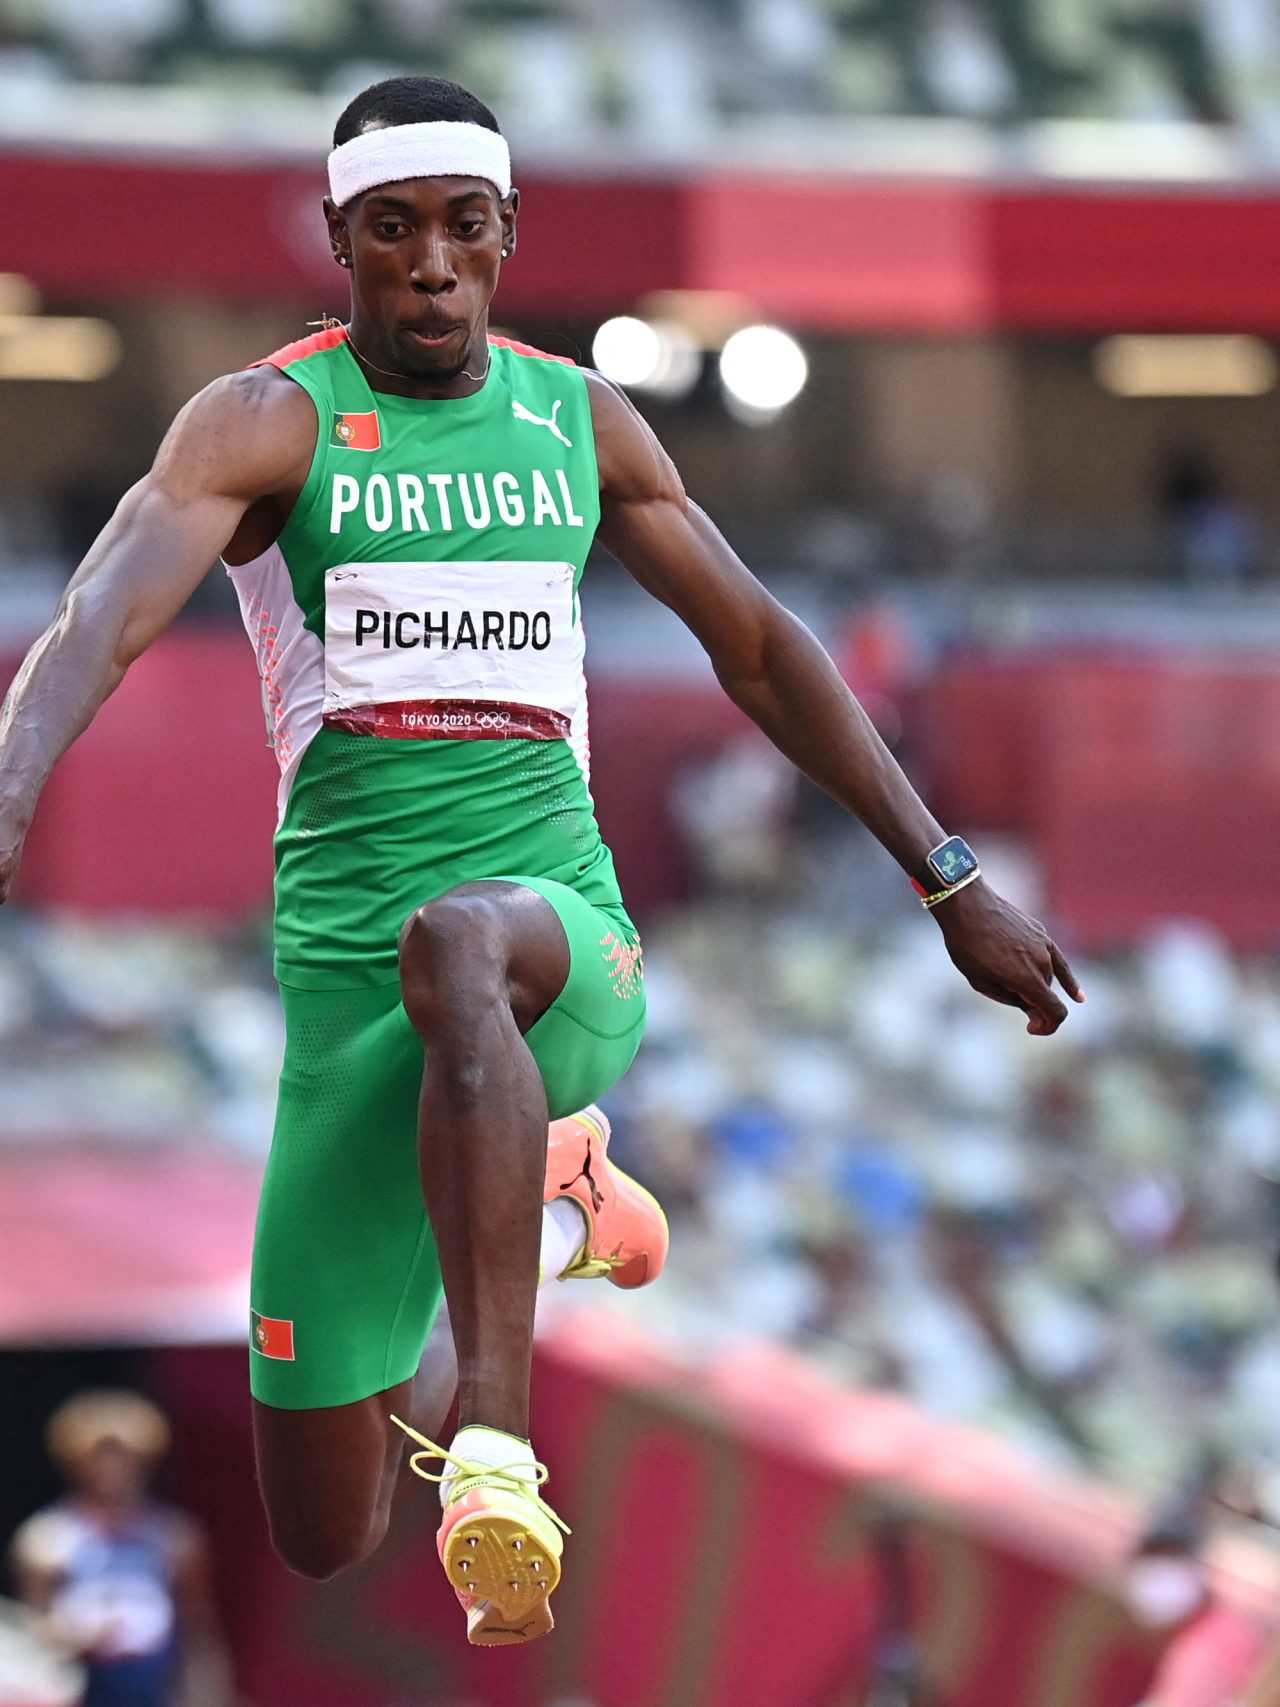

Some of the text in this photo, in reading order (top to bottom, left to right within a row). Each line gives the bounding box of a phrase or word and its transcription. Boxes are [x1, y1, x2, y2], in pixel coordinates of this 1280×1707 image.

[330, 469, 584, 534] PORTUGAL
[355, 609, 551, 651] PICHARDO
[401, 713, 471, 727] TOKYO 2020
